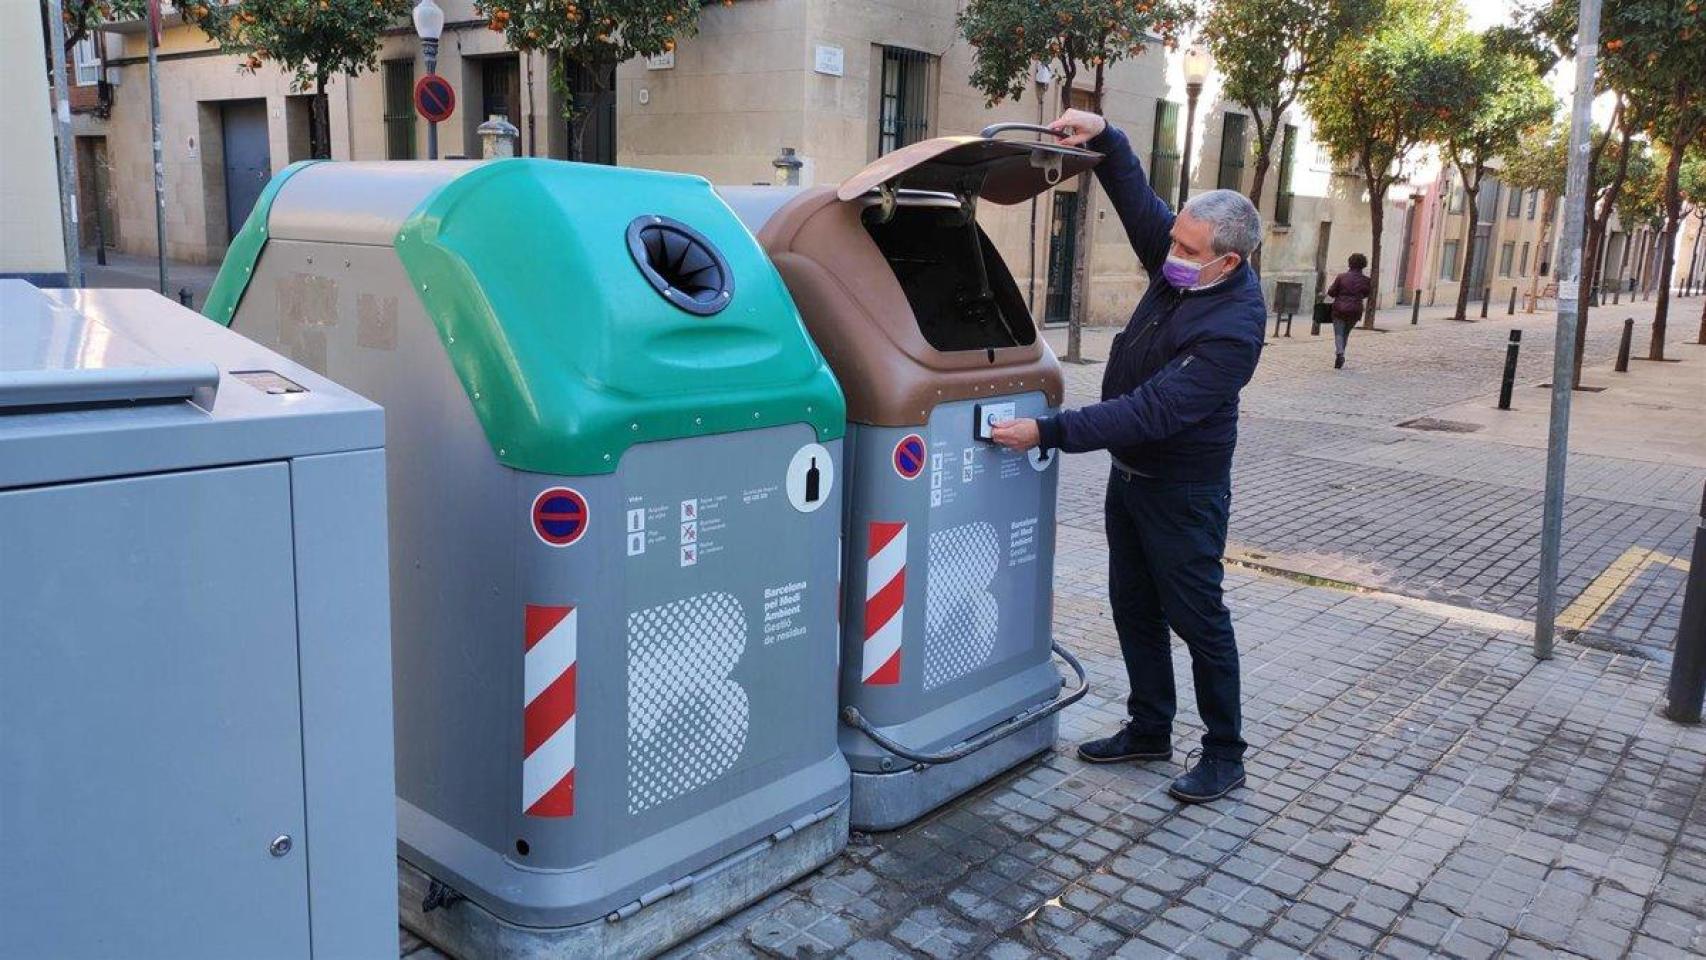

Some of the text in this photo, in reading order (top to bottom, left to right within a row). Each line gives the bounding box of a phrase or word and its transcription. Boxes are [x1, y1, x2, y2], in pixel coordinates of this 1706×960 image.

[764, 581, 807, 599] Barcelona
[764, 592, 801, 612] pel Medi
[764, 605, 801, 622] Ambient
[764, 618, 792, 633] Gestió
[764, 626, 807, 645] de residus
